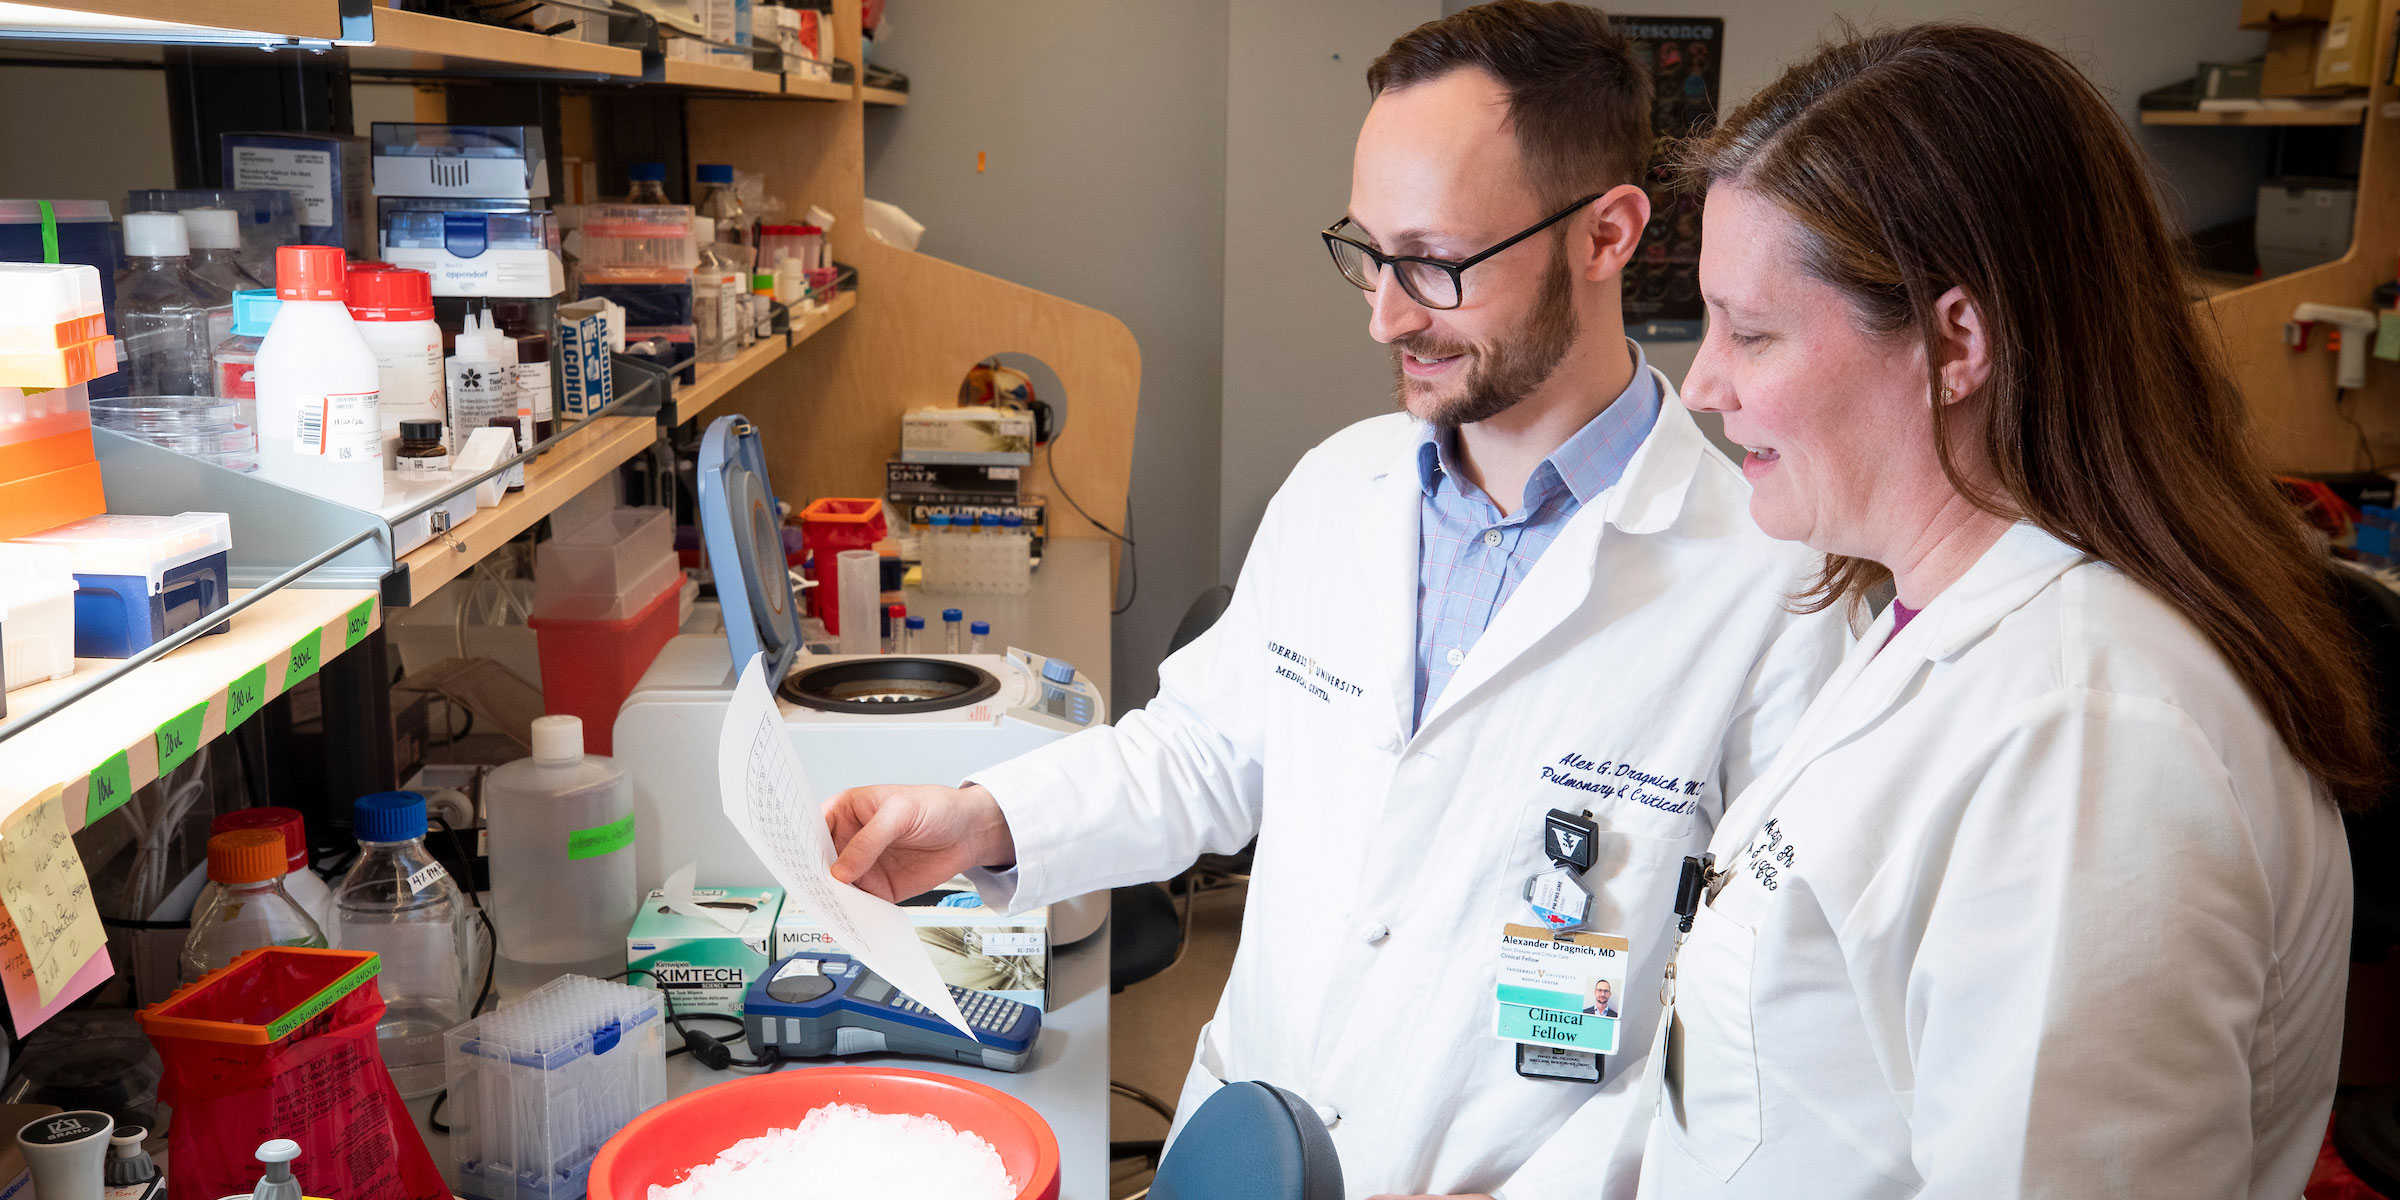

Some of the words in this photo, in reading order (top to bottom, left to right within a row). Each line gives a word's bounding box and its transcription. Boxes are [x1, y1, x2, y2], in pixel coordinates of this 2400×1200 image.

[446, 270, 488, 279] eppendorf
[890, 471, 937, 481] ONYX
[1316, 666, 1363, 697] UNIVERSITY
[1559, 752, 1595, 771] Alex
[1597, 761, 1612, 775] G.
[1614, 763, 1679, 793] Dragnich,
[1541, 766, 1615, 799] Pulmonary
[1617, 784, 1630, 799] &
[1631, 788, 1688, 815] Critical
[761, 939, 767, 951] 1
[1503, 935, 1548, 949] Alexander
[1552, 942, 1597, 957] Dragnich,
[1598, 948, 1616, 958] MD
[1521, 955, 1539, 963] Fellow
[656, 969, 742, 982] KIMTECH
[1506, 966, 1536, 975] VANDERBILT
[1545, 972, 1576, 980] UNIVERSITY
[300, 995, 333, 1023] BIOHAZARD
[1529, 1007, 1583, 1025] Clinical
[1532, 1025, 1577, 1042] Fellow
[47, 1126, 91, 1140] BRAND
